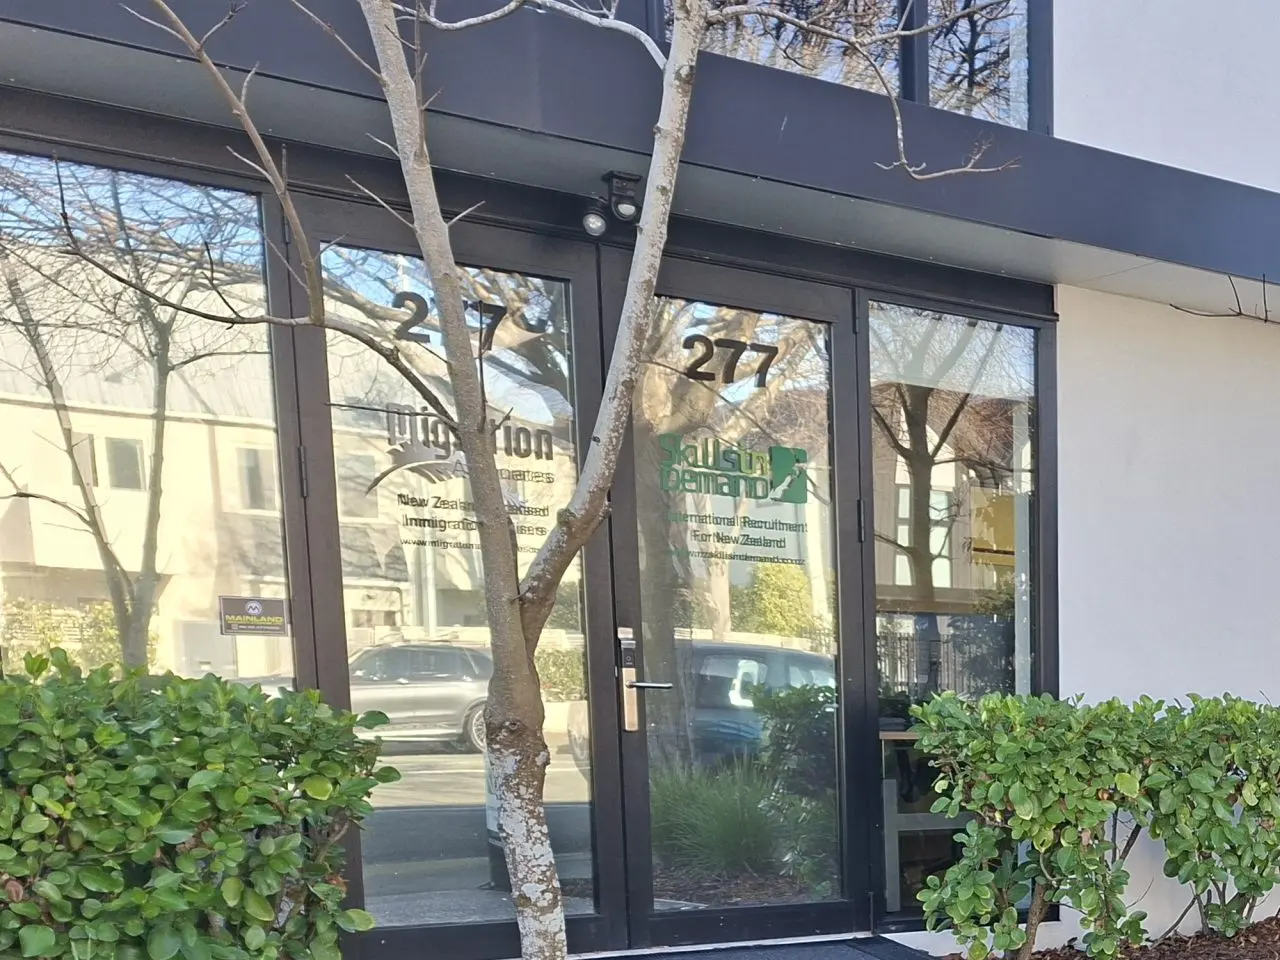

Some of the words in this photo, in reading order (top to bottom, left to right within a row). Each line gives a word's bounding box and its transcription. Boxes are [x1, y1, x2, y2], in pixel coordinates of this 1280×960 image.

[391, 291, 507, 350] 27
[683, 333, 778, 387] 277
[397, 493, 428, 508] New
[431, 496, 476, 512] Zealan
[667, 511, 739, 527] International
[740, 515, 808, 533] Recruitment
[690, 529, 712, 543] For
[712, 531, 740, 545] New
[740, 534, 786, 548] Zealand
[225, 615, 284, 623] MAINLAND
